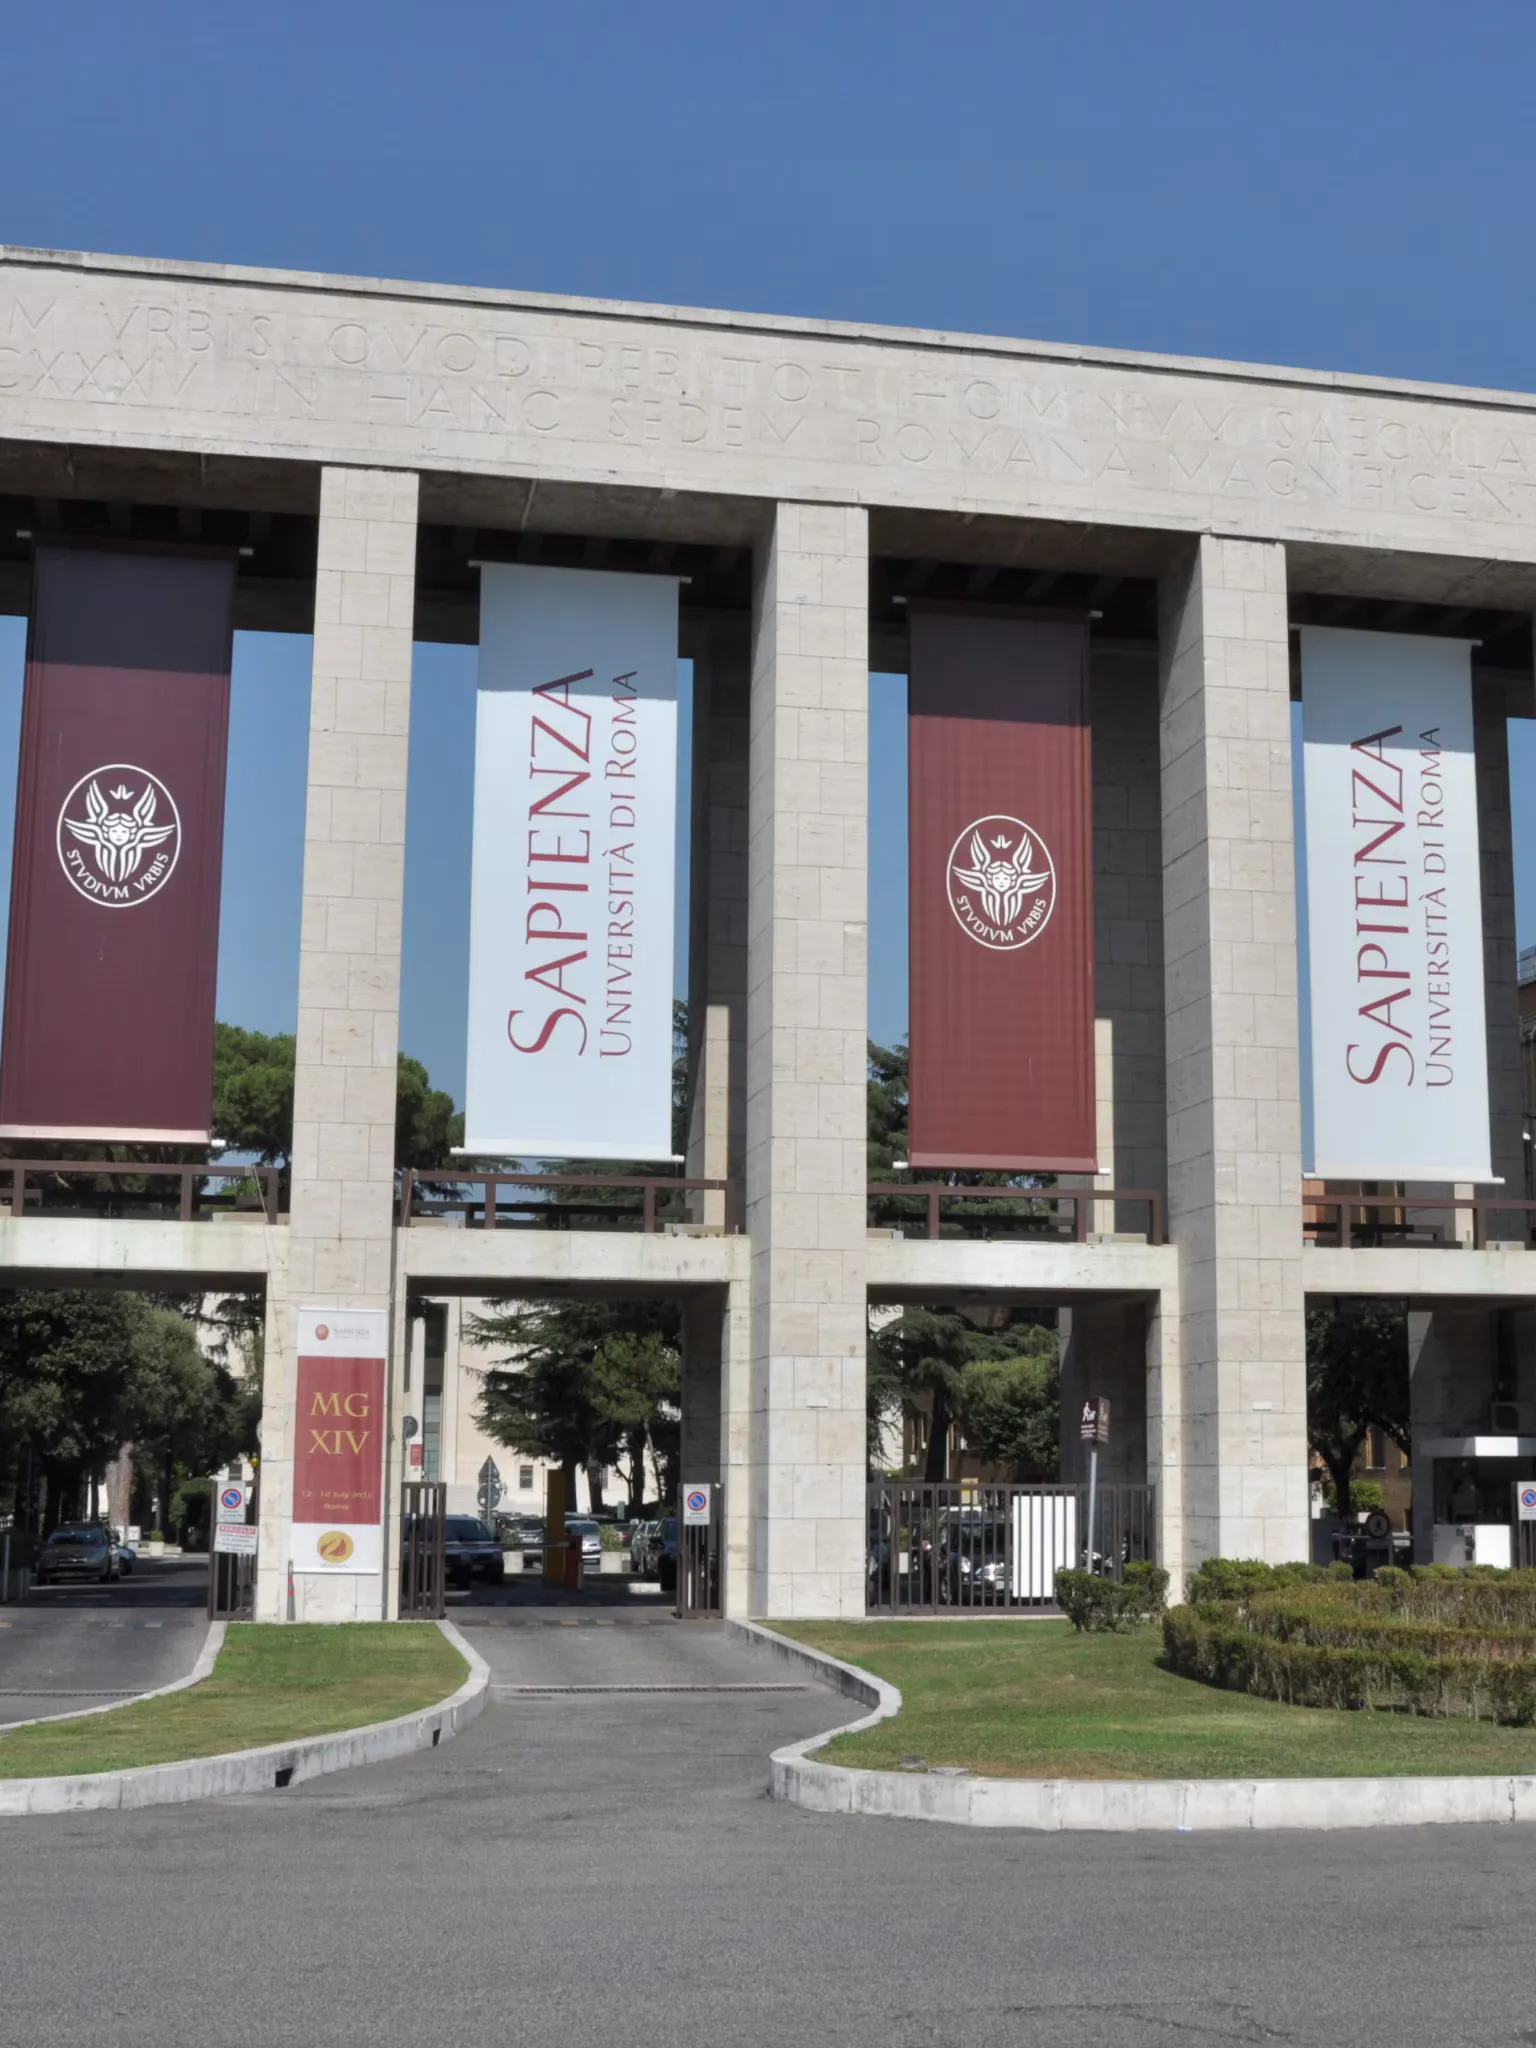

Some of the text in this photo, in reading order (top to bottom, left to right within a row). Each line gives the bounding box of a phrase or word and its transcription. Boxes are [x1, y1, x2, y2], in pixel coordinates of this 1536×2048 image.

[98, 299, 273, 358] VRBIS
[577, 341, 688, 397] PER
[254, 365, 318, 414] IN
[368, 376, 561, 432] HANC
[67, 849, 169, 899] STVDIVM VRBIS
[507, 667, 594, 1056] SAPIENZA
[600, 670, 638, 1058] UNIVERSITÀ DI ROMA
[956, 895, 1047, 942] STVDIVM VRBIS
[1346, 724, 1415, 1087] SAPIENZA
[1416, 727, 1454, 1089] UNIVERSITÀ DI ROMA
[308, 1429, 371, 1455] XIV
[310, 1391, 370, 1418] MG
